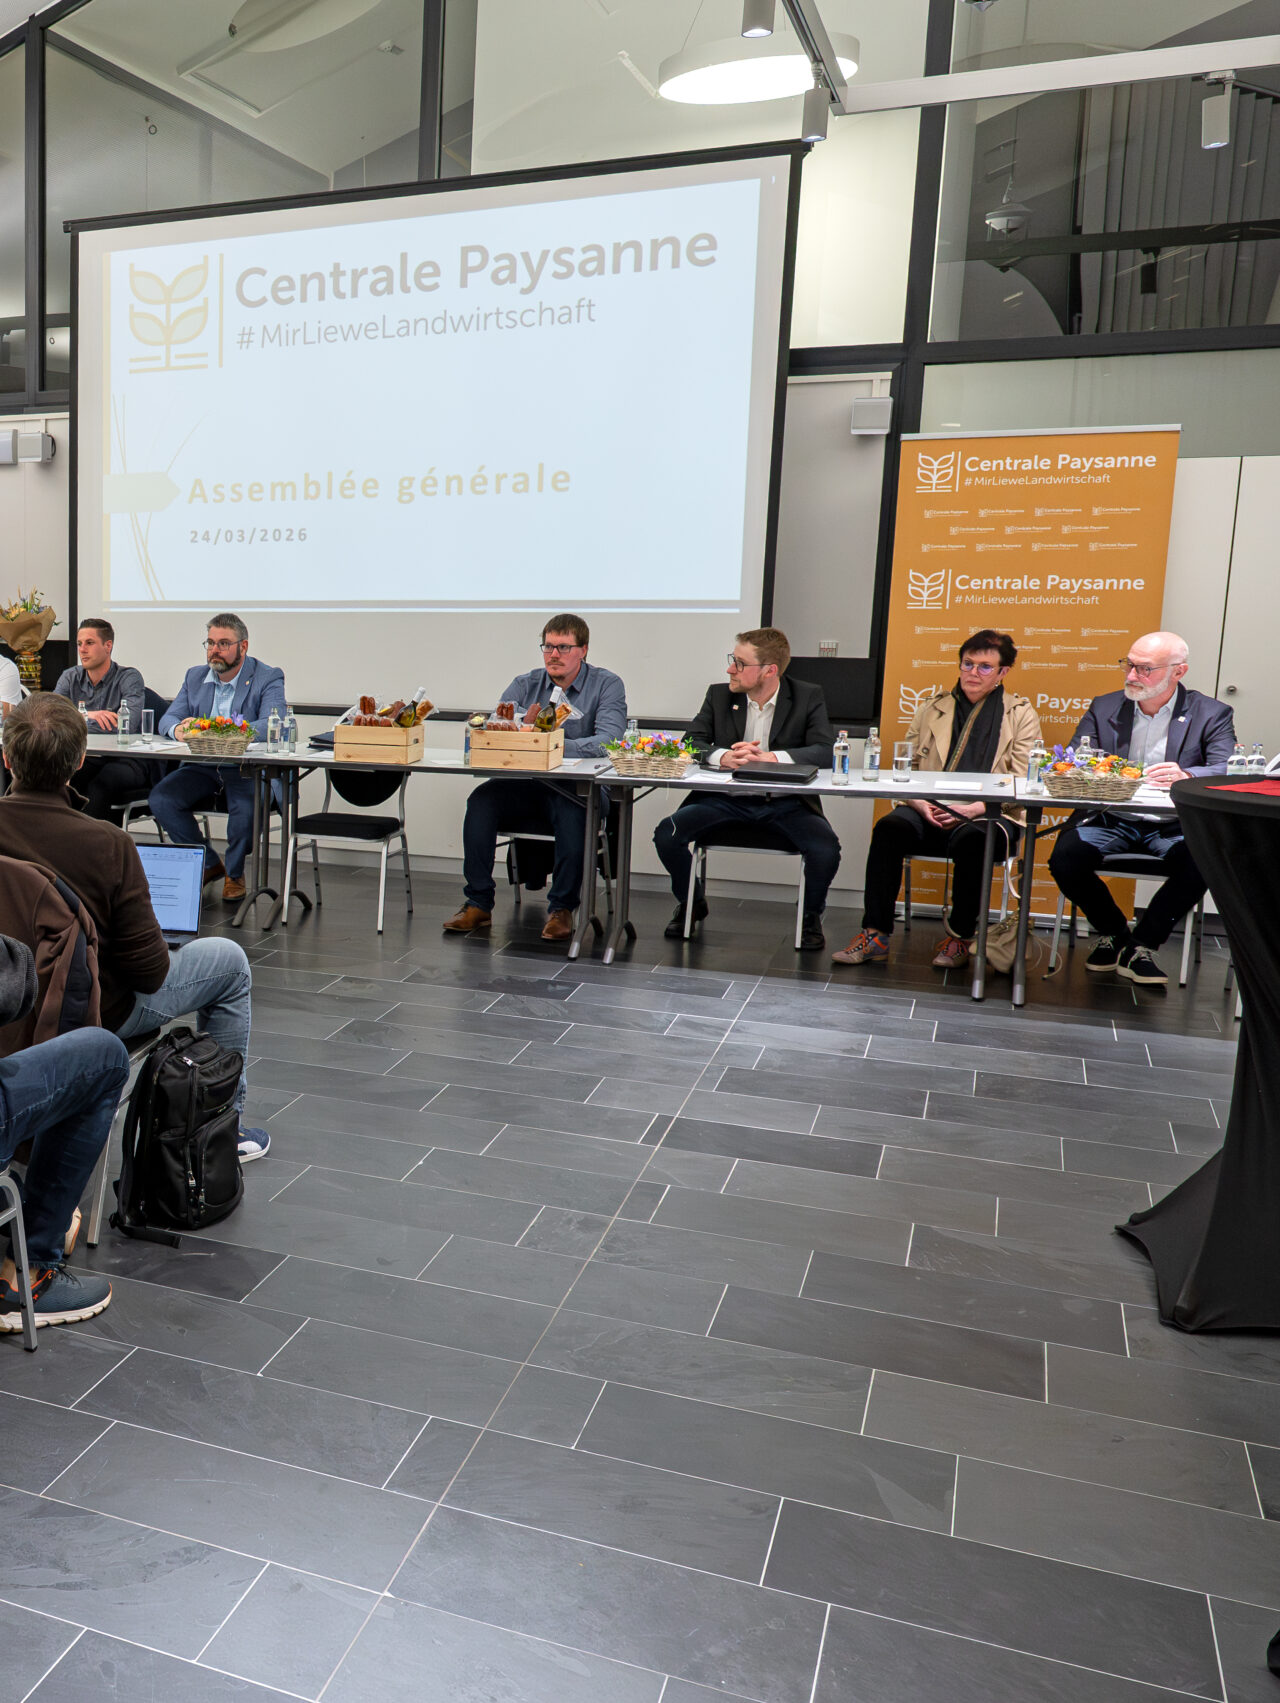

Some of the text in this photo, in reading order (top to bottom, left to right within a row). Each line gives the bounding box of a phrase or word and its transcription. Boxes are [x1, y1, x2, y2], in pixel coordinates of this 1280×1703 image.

[235, 232, 718, 308] Centrale Paysanne
[236, 298, 596, 350] #MirLieweLandwirtschaft
[964, 454, 1157, 473] Centrale Paysanne
[188, 462, 572, 504] Assemblée générale
[190, 528, 308, 545] 24/03/2026
[955, 574, 1145, 593] Centrale Paysanne
[1036, 693, 1093, 712] Paysa
